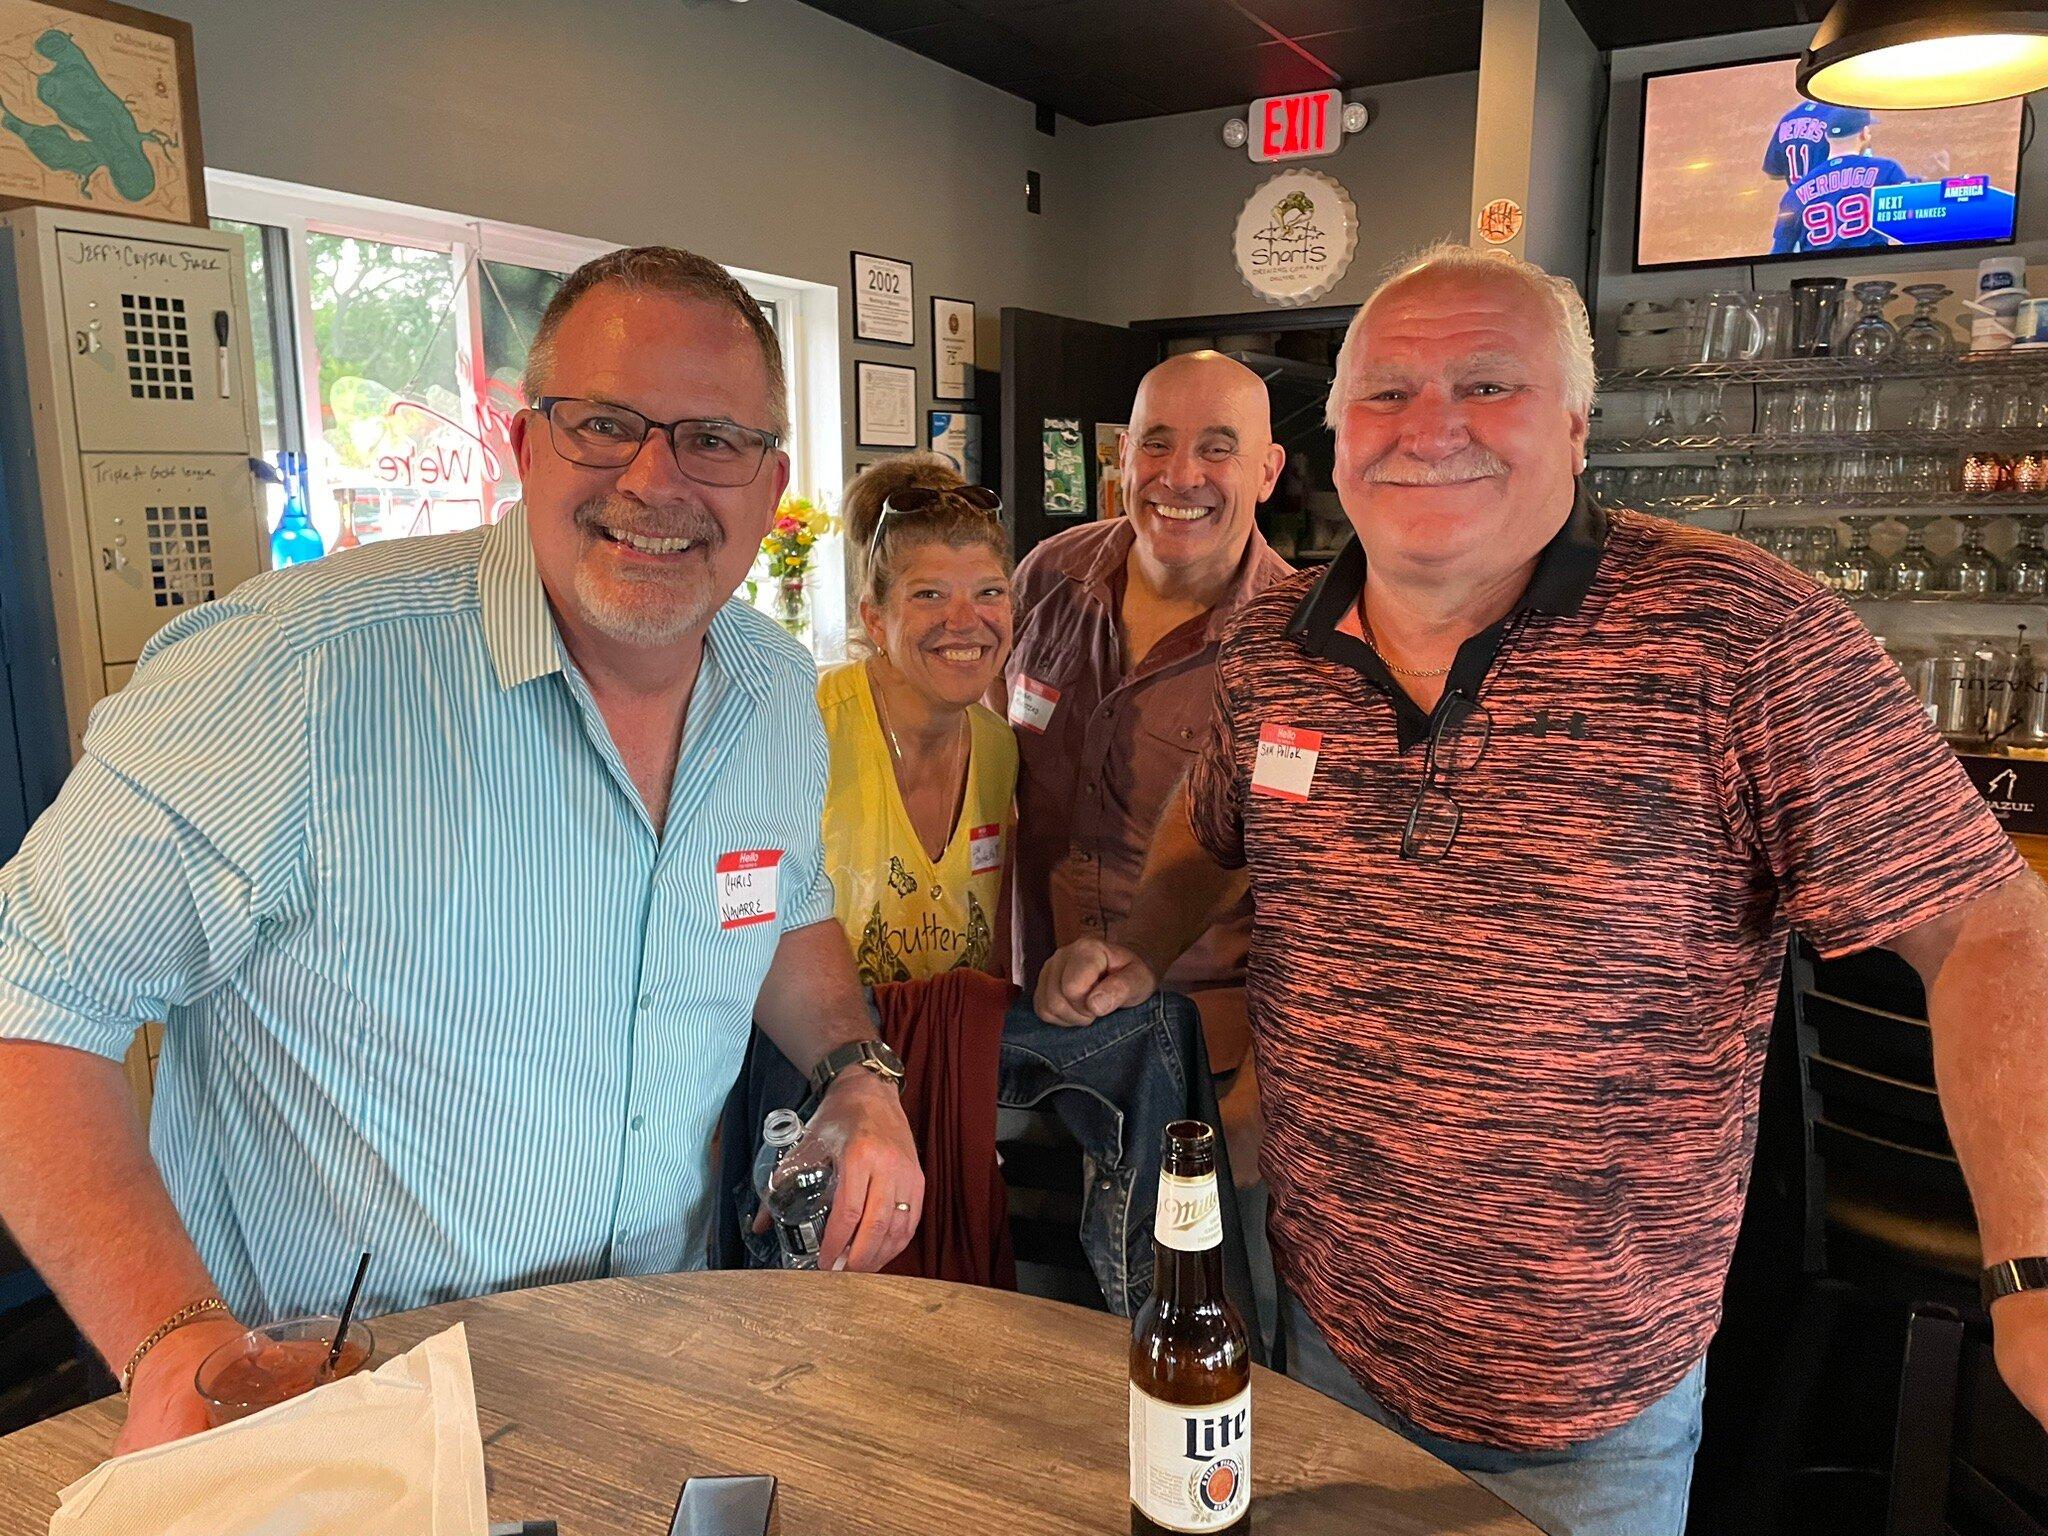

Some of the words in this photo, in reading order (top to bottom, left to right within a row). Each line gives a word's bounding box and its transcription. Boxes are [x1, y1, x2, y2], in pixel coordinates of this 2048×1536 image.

[1263, 93, 1331, 157] EXIT
[1786, 144, 1808, 184] 11
[1796, 167, 1879, 204] VERDUGO
[1944, 185, 1983, 198] AMERICA
[1877, 211, 1891, 222] RED
[1893, 210, 1907, 221] SOX
[1915, 207, 1946, 219] YANKEES
[1878, 196, 1903, 210] NEXT
[1803, 194, 1872, 246] 99
[868, 269, 900, 294] 2002
[740, 852, 759, 863] Hello
[725, 873, 752, 896] CHRIS
[1182, 1408, 1246, 1462] Lite
